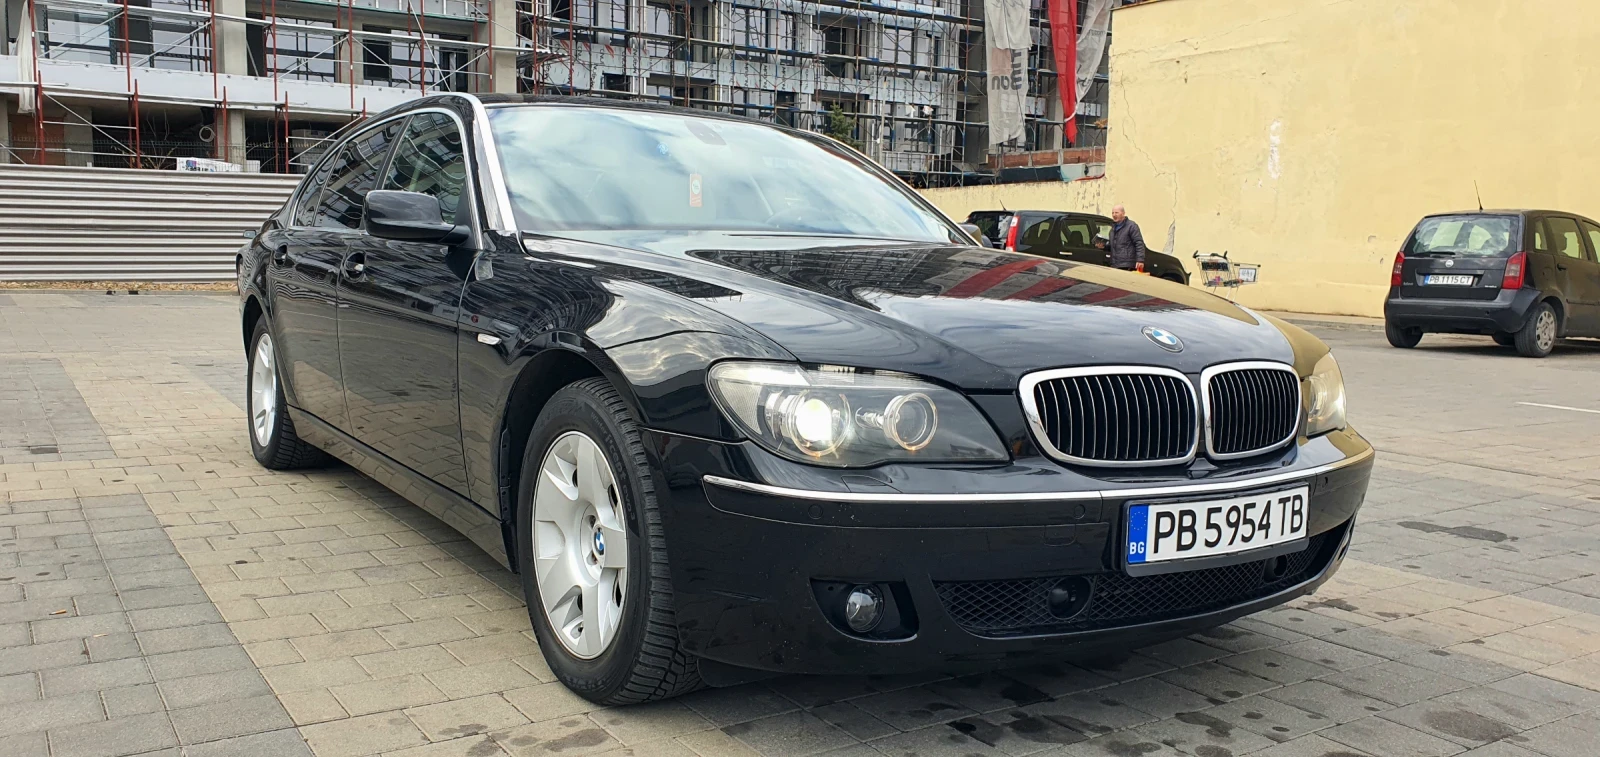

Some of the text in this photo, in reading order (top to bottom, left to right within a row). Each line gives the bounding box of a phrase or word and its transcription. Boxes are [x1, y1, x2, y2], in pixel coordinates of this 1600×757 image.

[1429, 275, 1440, 283] PB
[1441, 276, 1459, 284] 1115
[1460, 276, 1472, 284] CT
[1153, 494, 1303, 553] PB 5954 TB
[1130, 541, 1145, 554] BG
